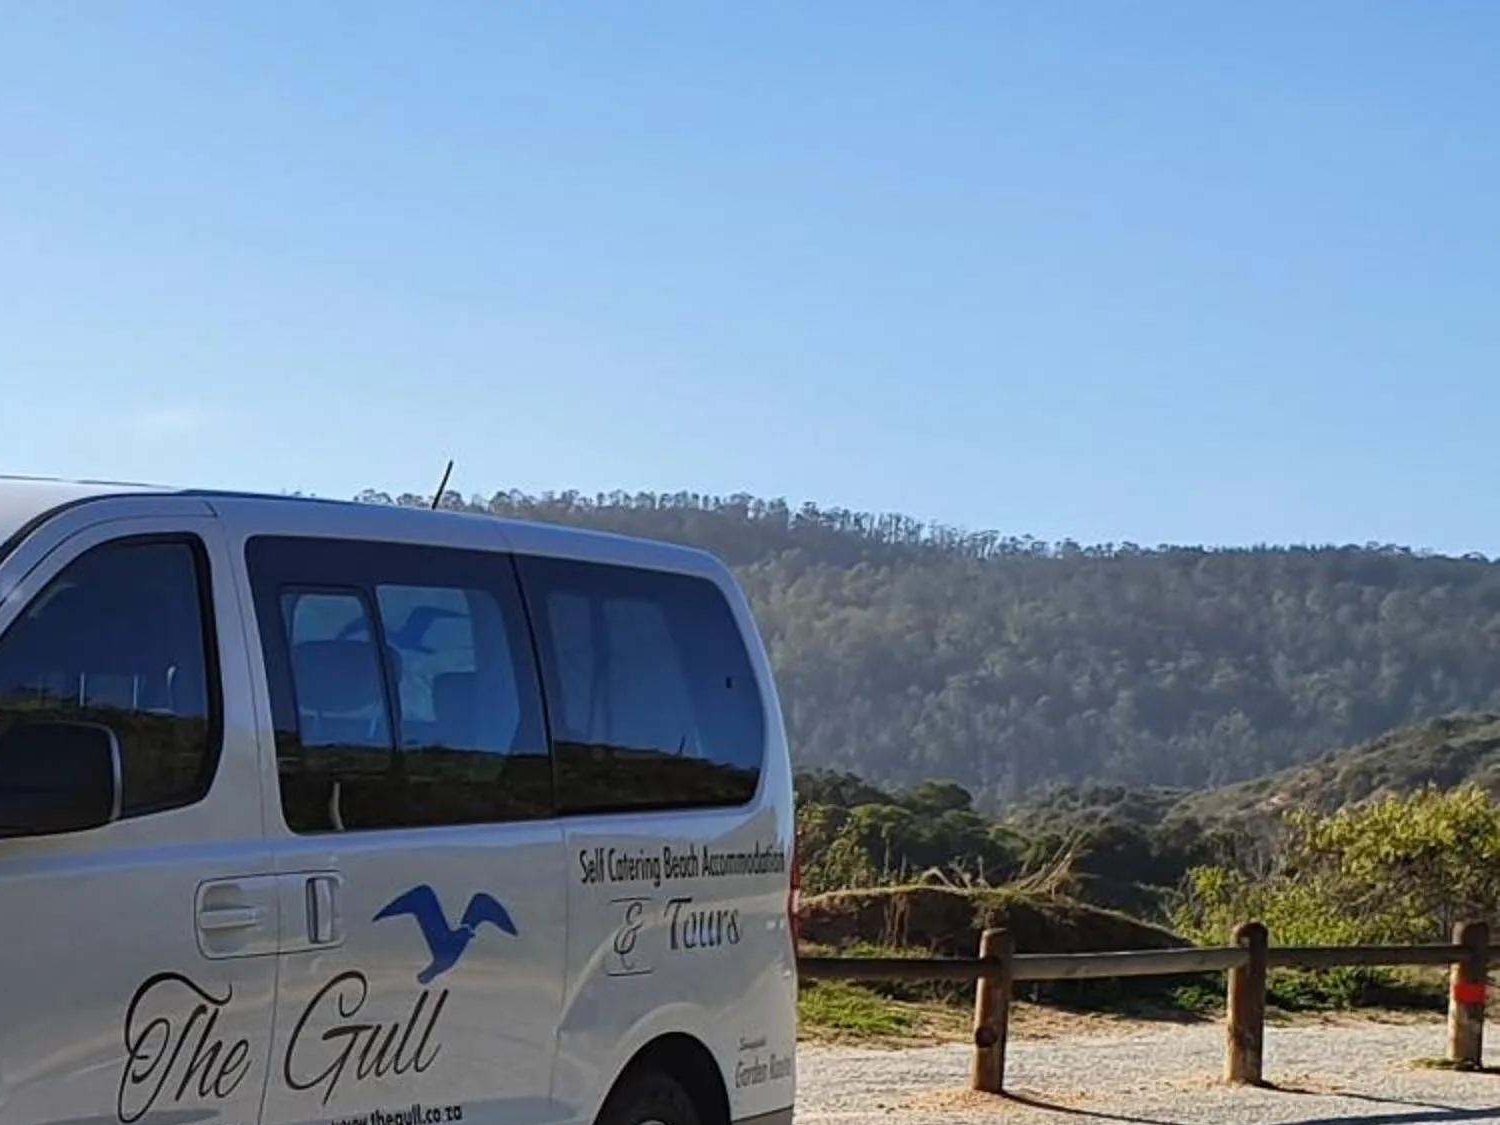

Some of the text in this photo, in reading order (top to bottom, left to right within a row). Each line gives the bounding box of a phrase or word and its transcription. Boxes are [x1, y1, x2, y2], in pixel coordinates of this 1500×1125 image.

[579, 847, 606, 884] Self
[607, 848, 662, 887] Catering
[663, 841, 699, 879] Beach
[663, 897, 741, 950] Tours
[117, 970, 450, 1124] The Gull
